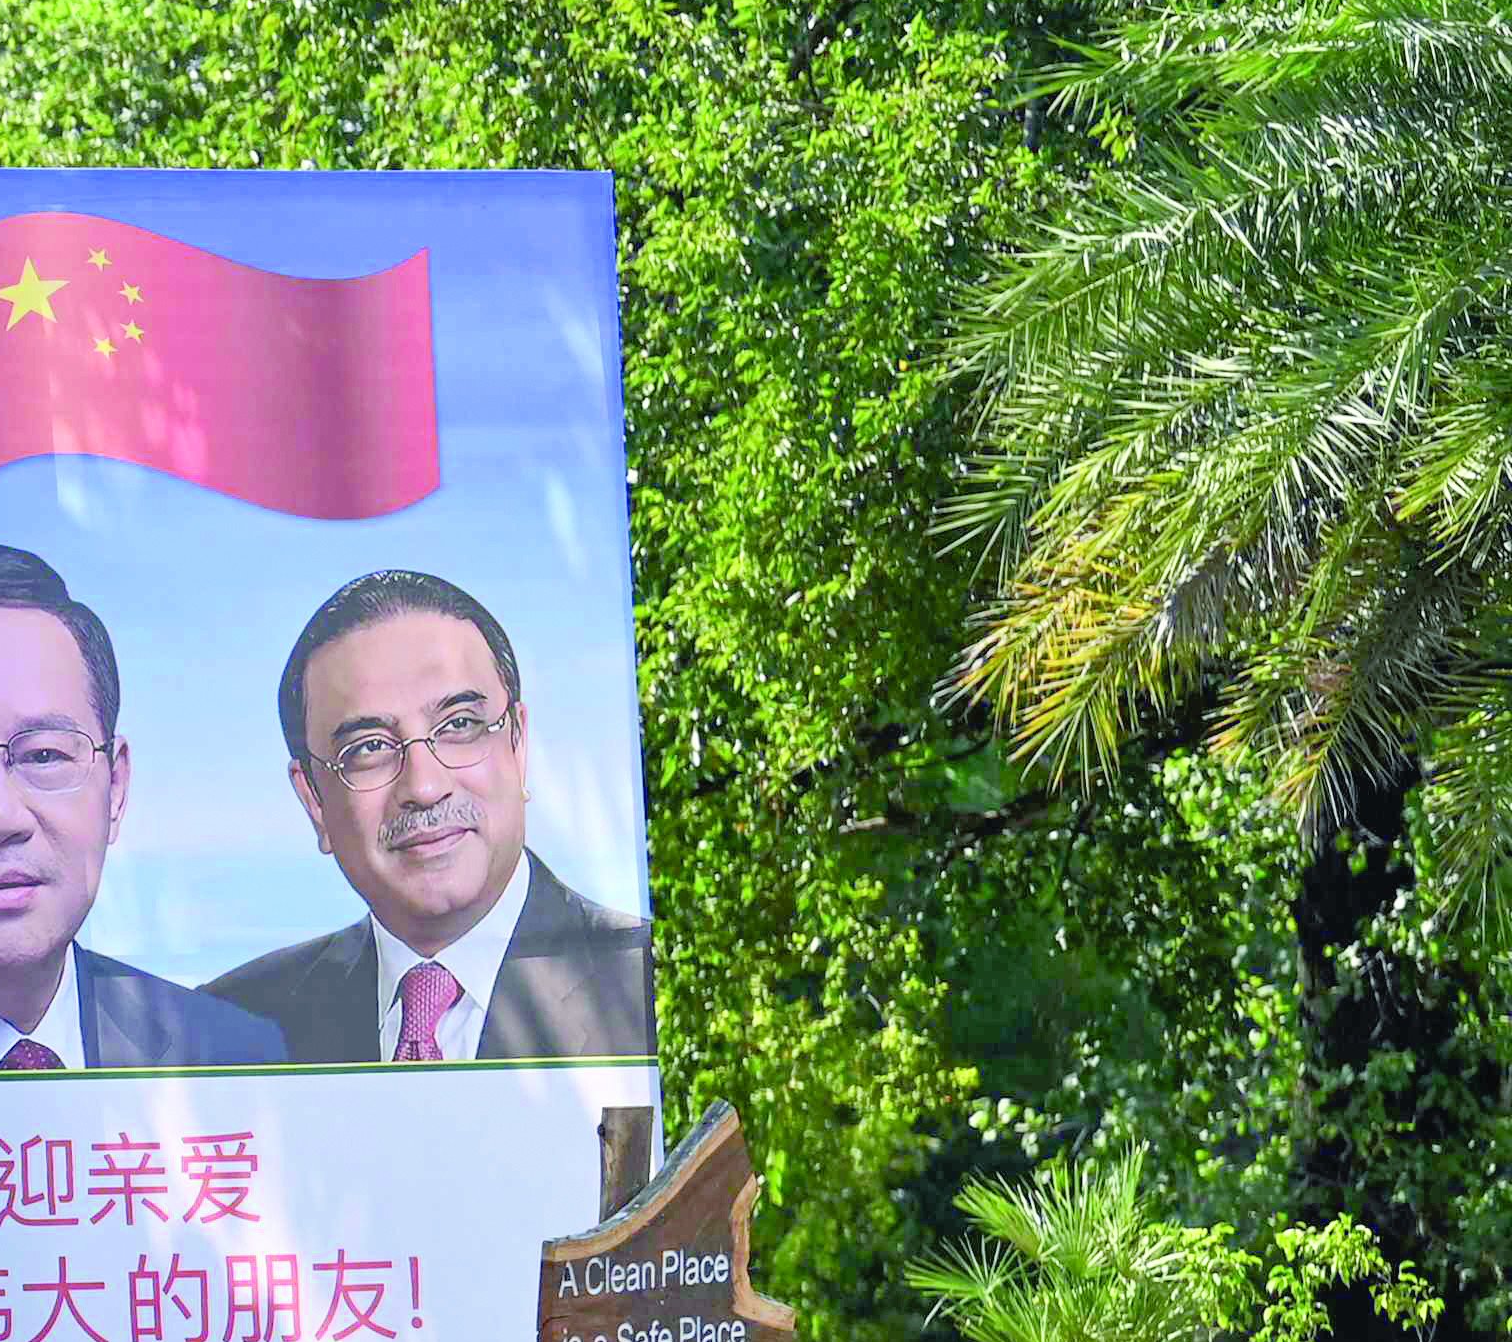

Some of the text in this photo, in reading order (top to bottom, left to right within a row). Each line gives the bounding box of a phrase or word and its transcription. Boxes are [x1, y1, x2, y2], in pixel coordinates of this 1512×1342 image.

[558, 1249, 729, 1299] A Clean Place
